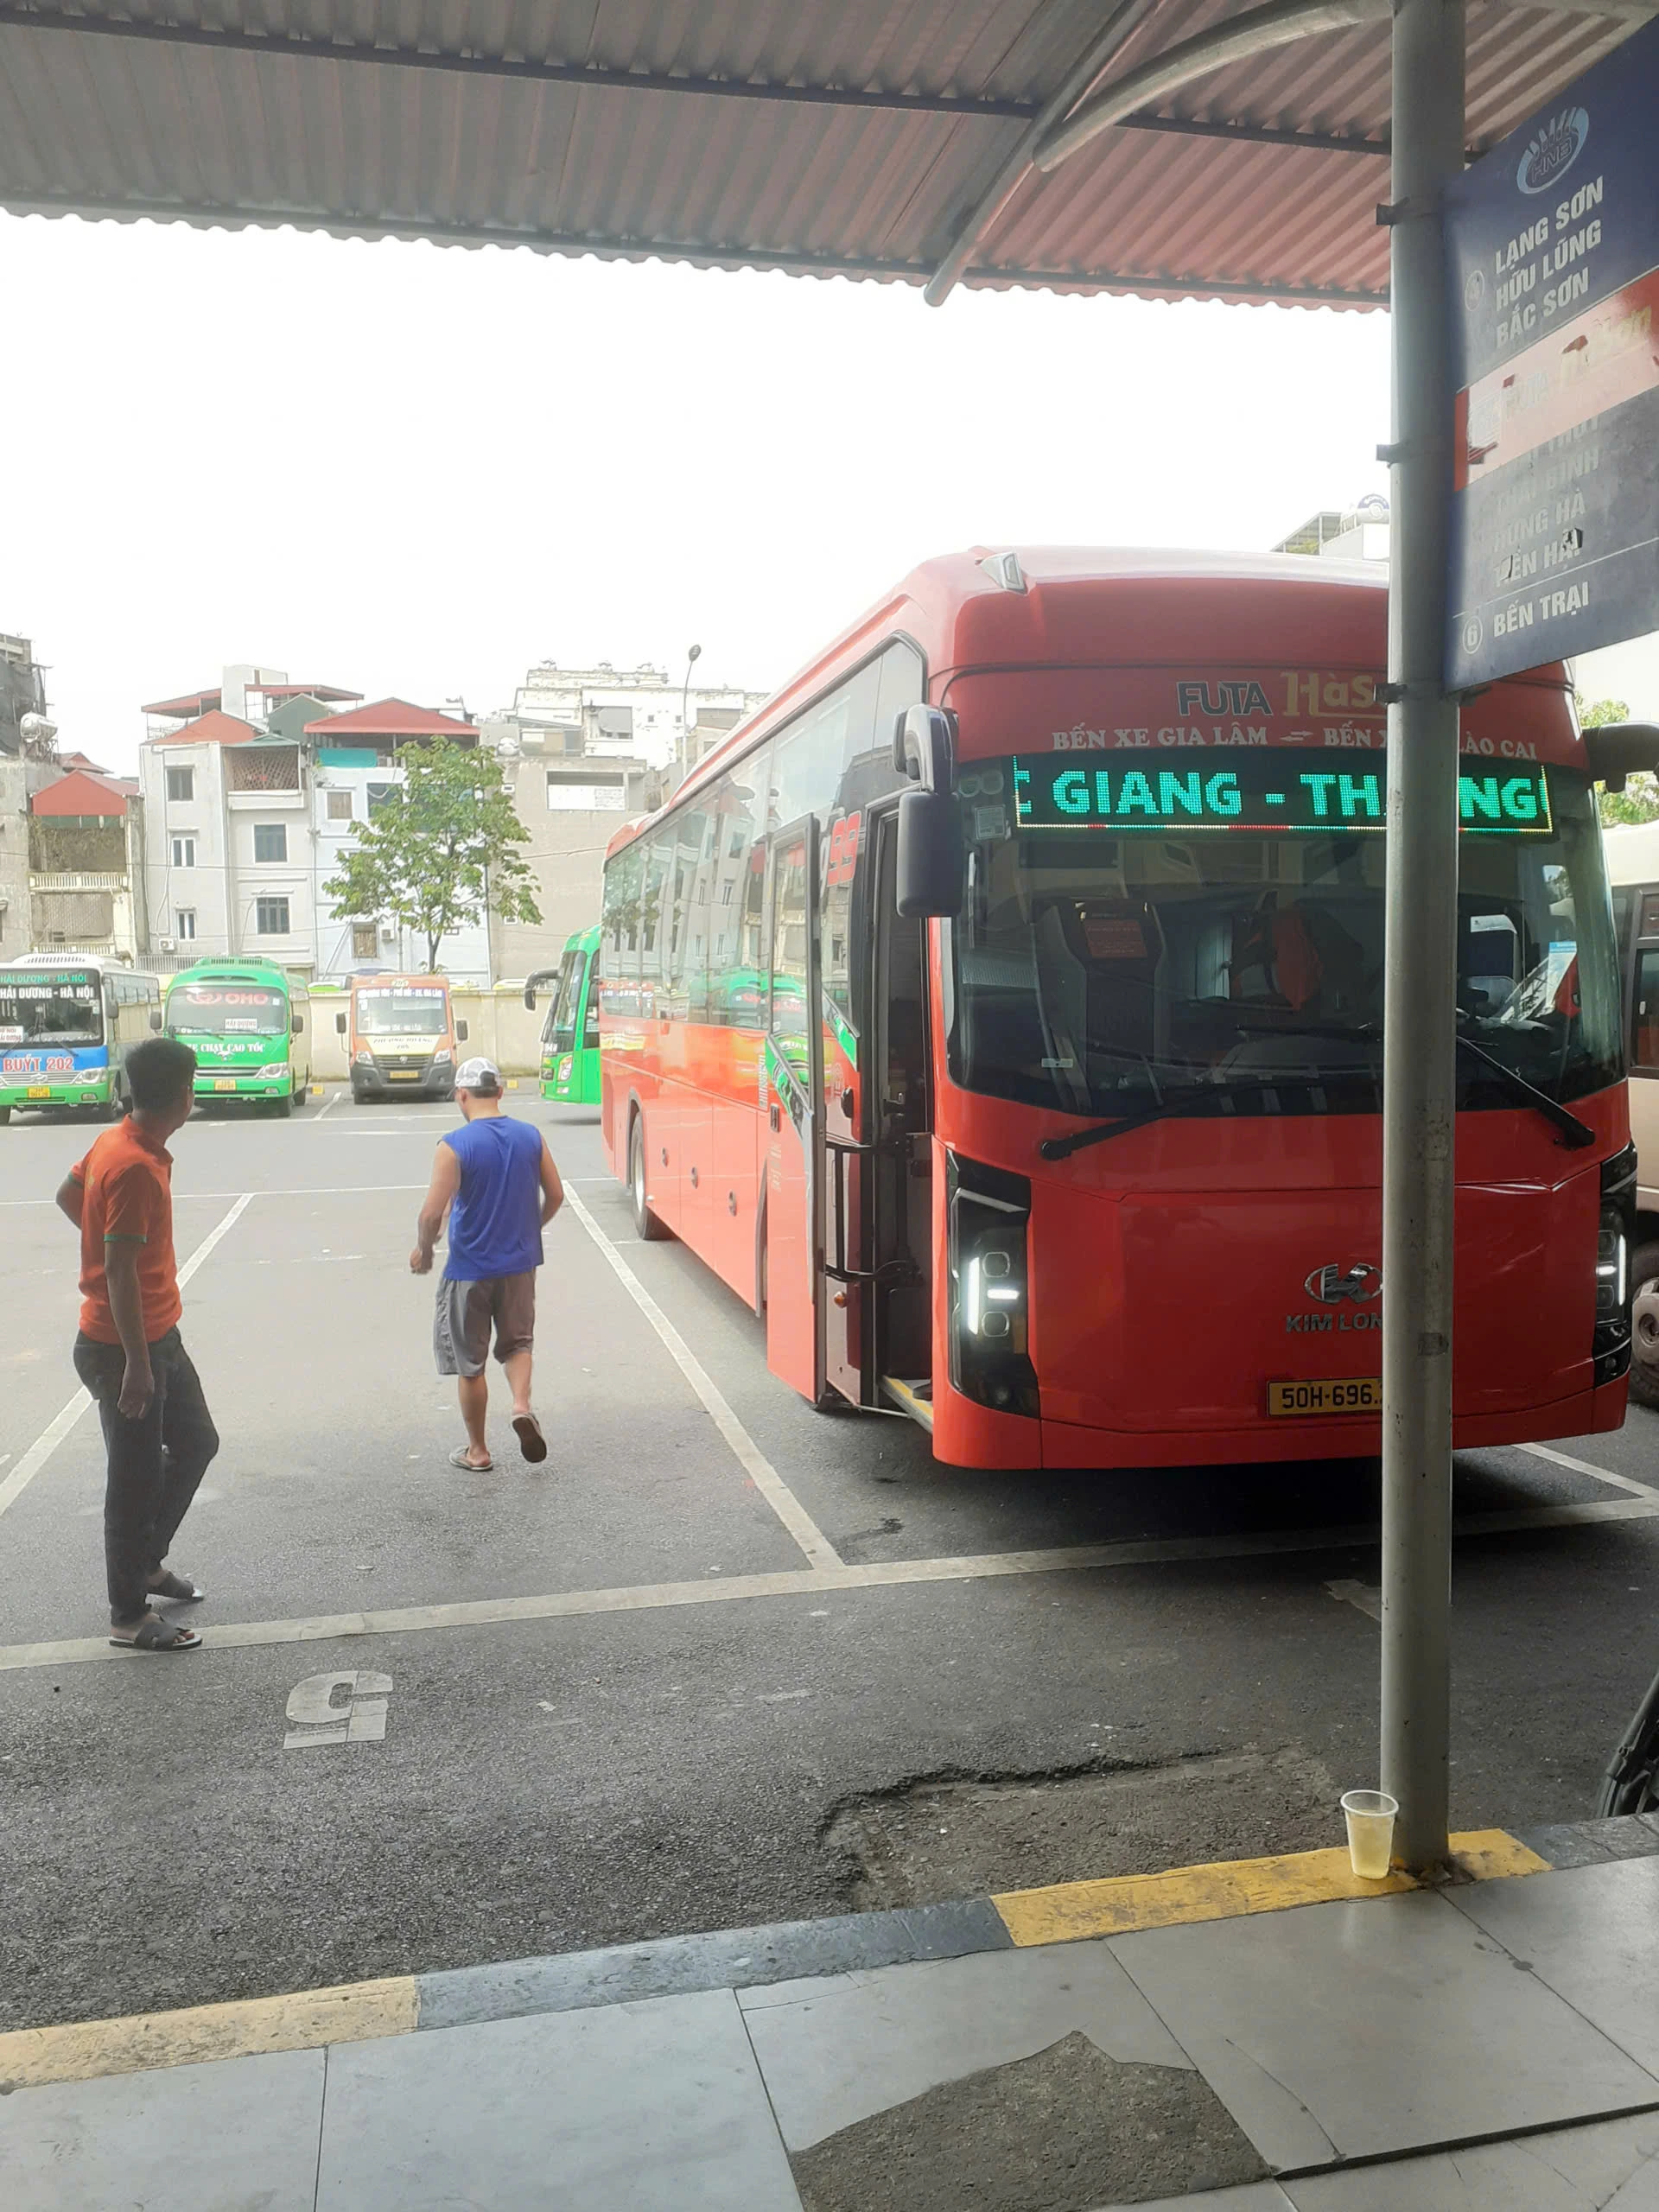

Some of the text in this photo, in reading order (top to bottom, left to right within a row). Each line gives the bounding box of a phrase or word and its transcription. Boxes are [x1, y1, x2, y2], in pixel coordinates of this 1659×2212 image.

[1496, 175, 1603, 275] LẠNG SƠN
[1496, 263, 1535, 312] HỮU
[1542, 219, 1601, 280] LŨNG
[1496, 267, 1589, 348] BẮC SƠN
[1493, 600, 1534, 638] BẾN
[1539, 581, 1589, 620] TRẠI
[1176, 680, 1274, 716] FUTA
[1052, 722, 1107, 750] BẾN
[1114, 728, 1150, 747] XE
[1158, 727, 1206, 746] GIA
[1212, 721, 1268, 746] LÂM
[1324, 720, 1372, 747] BẾN
[1459, 731, 1495, 755] ÀO
[1500, 739, 1537, 761] CAI
[1052, 770, 1243, 816] GIANG
[60, 985, 74, 999] HÀ
[47, 1057, 74, 1071] 202
[1286, 1313, 1382, 1333] KIM LON
[1281, 1383, 1382, 1409] 50H-696.
